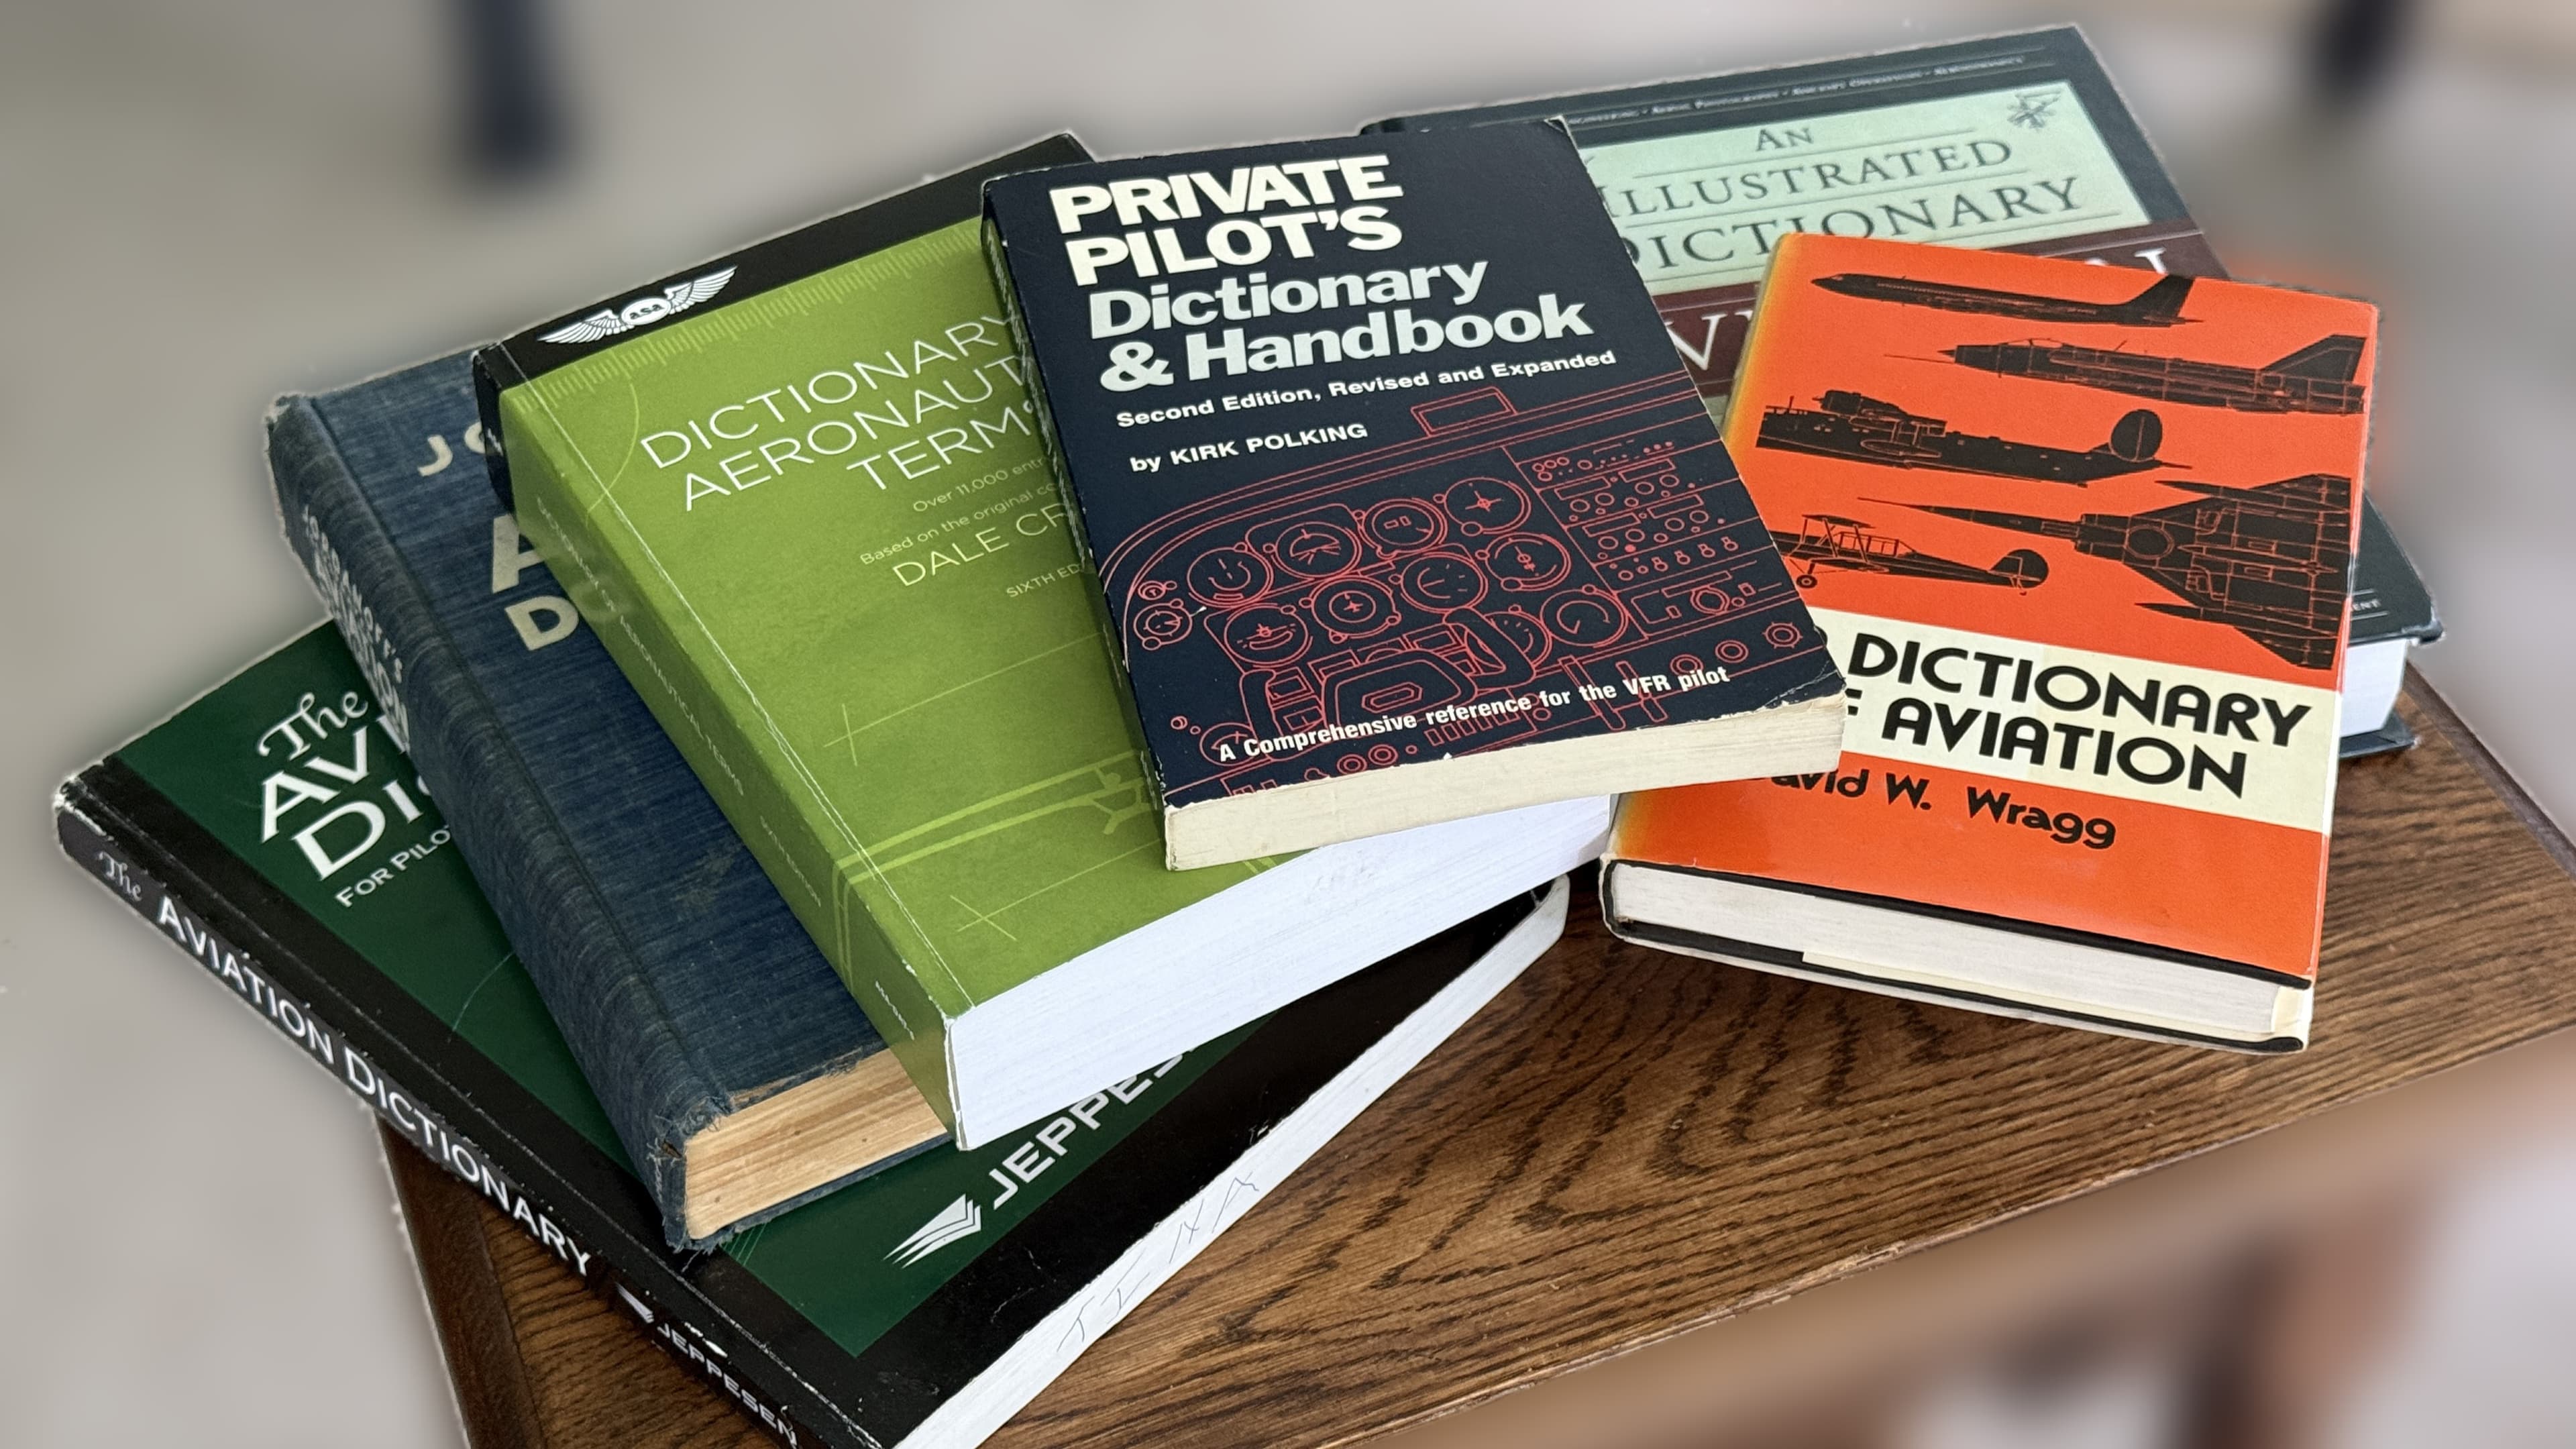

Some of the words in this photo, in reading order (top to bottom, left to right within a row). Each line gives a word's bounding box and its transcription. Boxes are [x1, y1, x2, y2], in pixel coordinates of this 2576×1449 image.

[1049, 154, 1403, 234] PRIVATE
[1065, 206, 1403, 286] PILOT'S
[1090, 260, 1489, 339] Dictionary
[1099, 341, 1174, 392] &
[1186, 293, 1593, 380] Handbook
[1116, 399, 1214, 428] Second
[1222, 384, 1322, 412] Edition,
[1328, 372, 1430, 398] Revised
[1438, 364, 1485, 384] and
[1491, 350, 1617, 382] Expanded
[685, 355, 1023, 511] AERONAUT
[1130, 456, 1161, 473] by
[1171, 441, 1239, 466] KIRK
[1246, 423, 1368, 453] POLKING
[913, 491, 953, 512] Over
[1012, 458, 1044, 475] entr
[860, 537, 913, 565] Based
[917, 527, 939, 543] on
[942, 516, 970, 533] the
[974, 490, 1034, 521] original
[893, 527, 1010, 587] DALE
[1006, 572, 1056, 598] SIXTH
[257, 691, 368, 761] The
[1219, 743, 1236, 763] A
[1243, 712, 1417, 757] Comprehensive
[1425, 698, 1532, 727] reference
[1540, 689, 1571, 708] for
[1578, 683, 1617, 703] the
[1621, 675, 1672, 698] VFR
[1677, 665, 1731, 694] pilot
[1847, 633, 2312, 748] DICTIONARY
[1881, 697, 2247, 799] AVIATION
[1886, 772, 1932, 810] W.
[1966, 786, 2116, 850] Wragg
[335, 867, 394, 908] FOR
[390, 825, 451, 871] PILO
[99, 851, 142, 902] The
[158, 896, 335, 1065] AVIATION
[344, 1047, 591, 1277] DICTIONARY
[989, 1054, 1183, 1210] JEPPE
[657, 1322, 798, 1449] JEPPESEN
